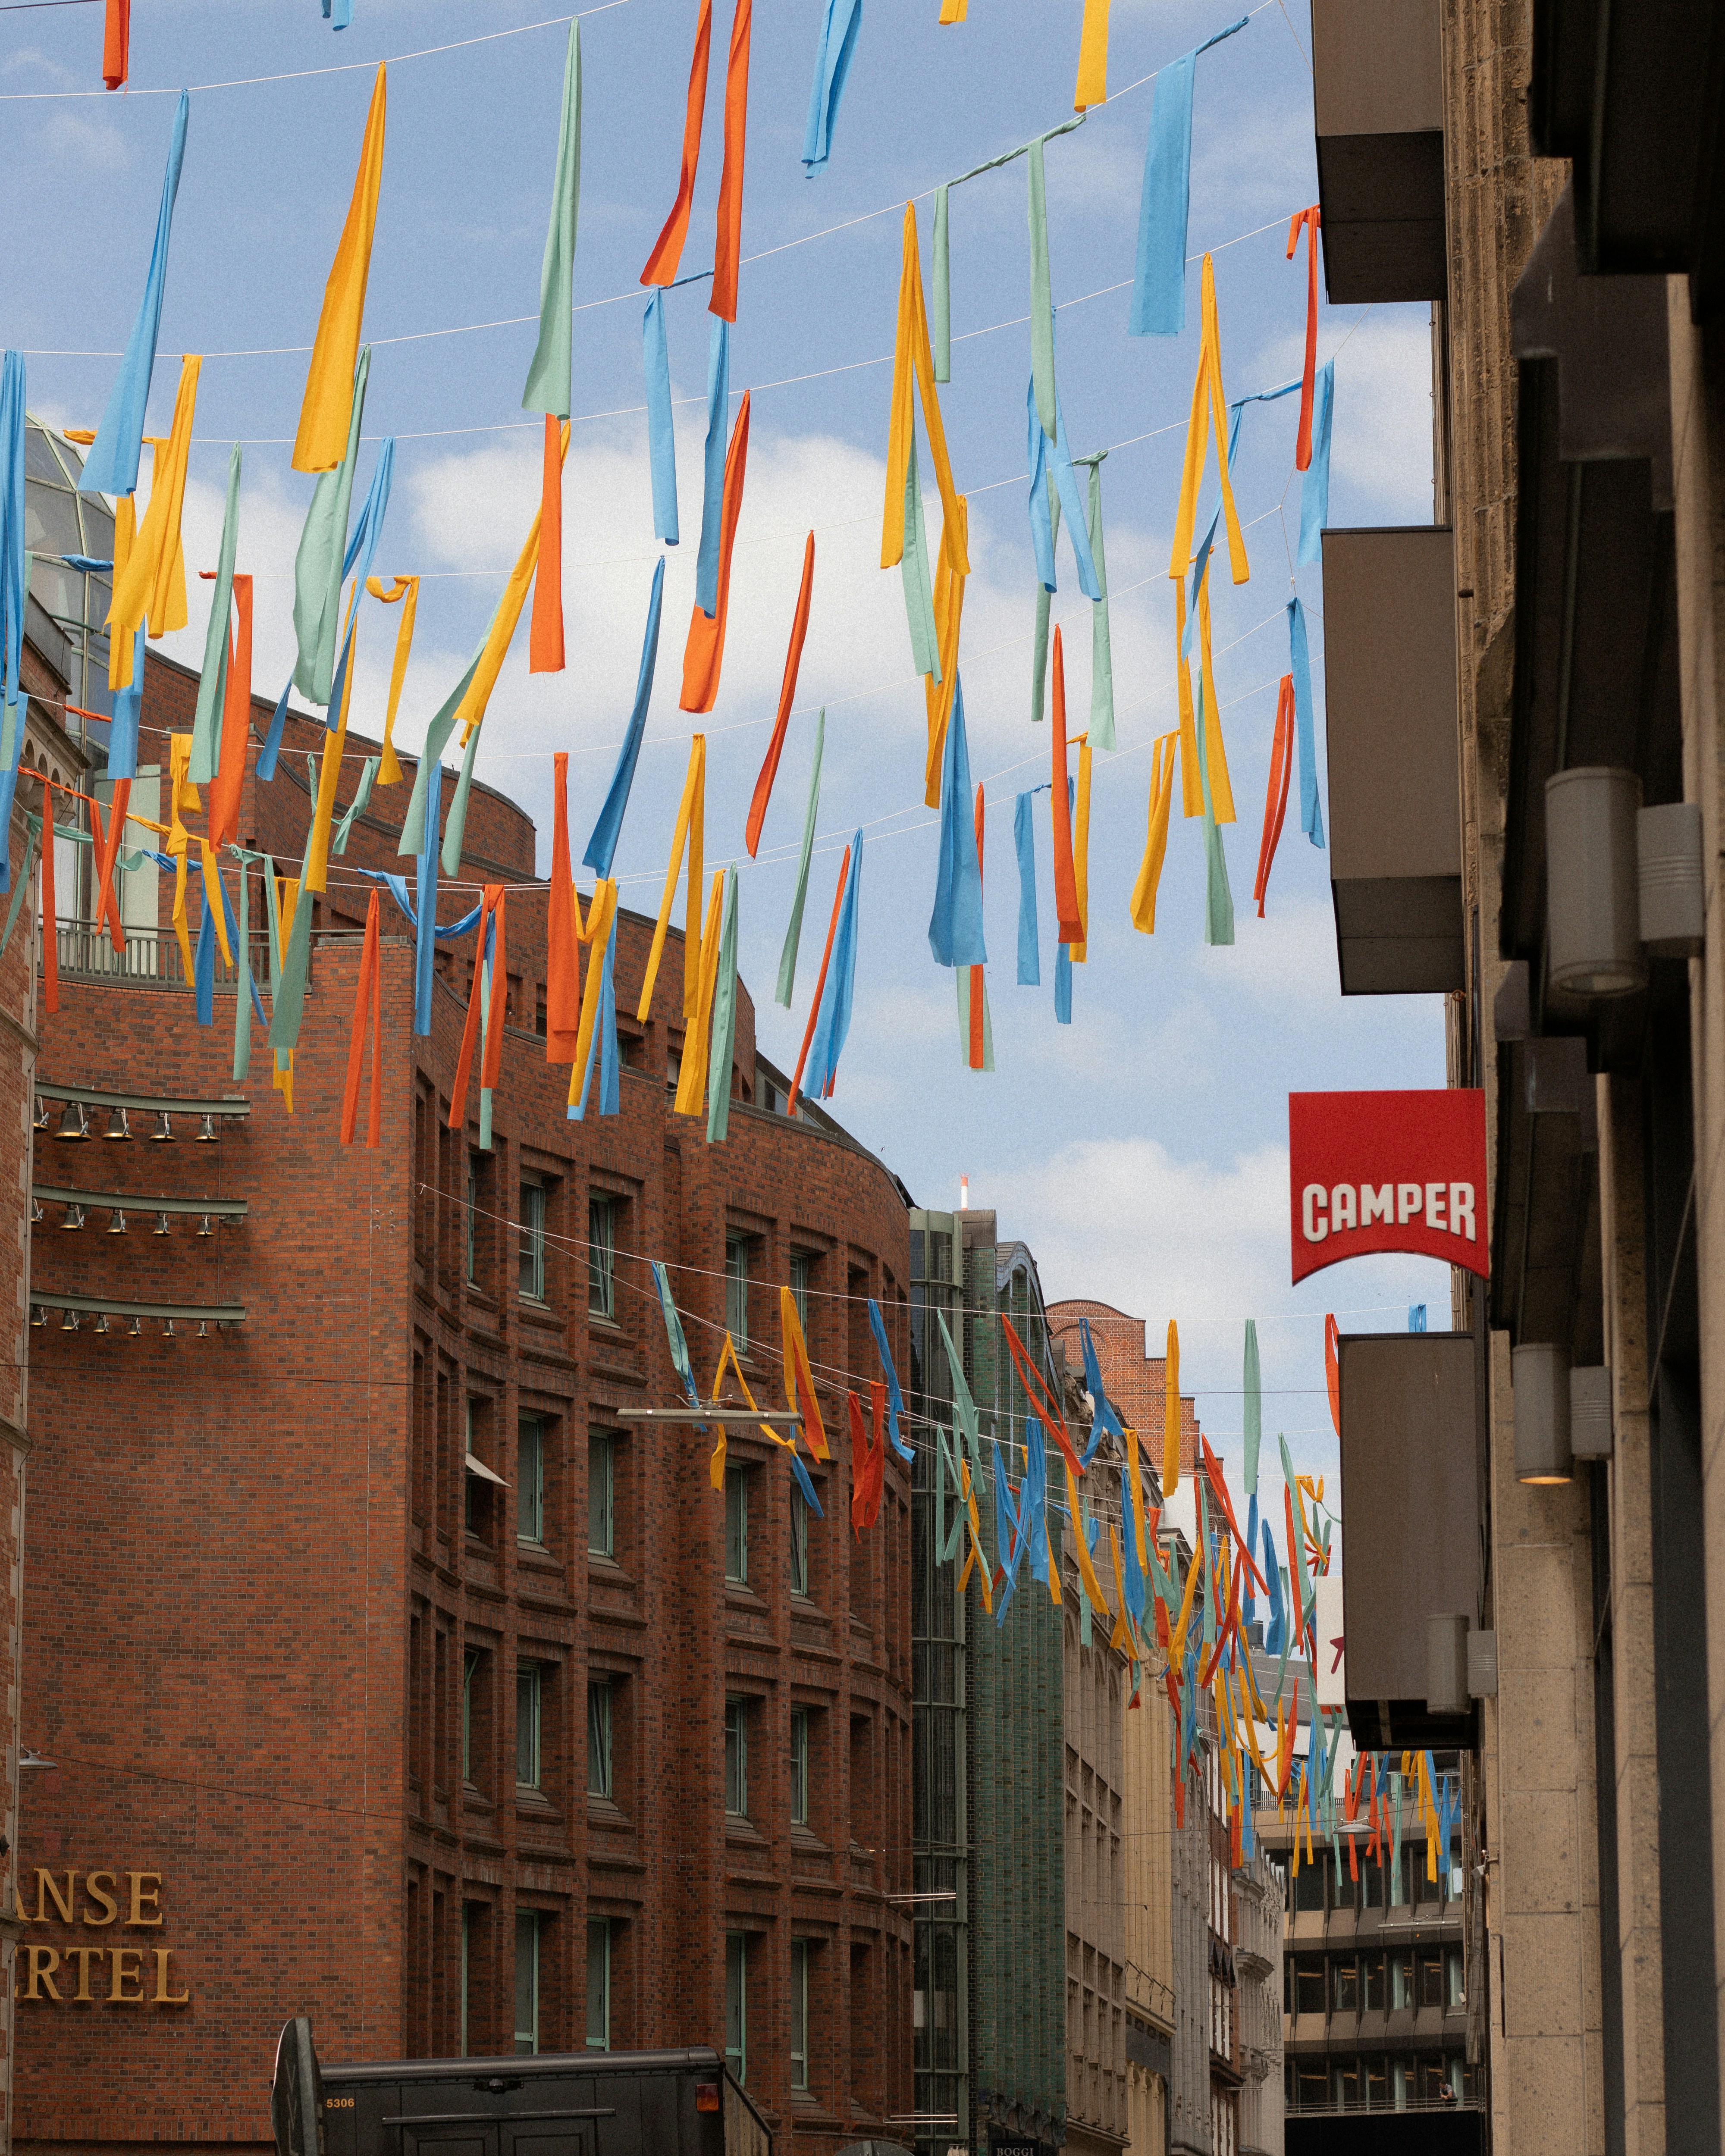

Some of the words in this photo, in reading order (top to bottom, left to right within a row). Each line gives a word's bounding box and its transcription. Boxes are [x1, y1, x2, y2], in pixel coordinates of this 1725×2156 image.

[1302, 1182, 1476, 1242] CAMPER
[15, 1945, 189, 2002] RTEL
[326, 2098, 354, 2108] 5306
[997, 2148, 1034, 2156] BOGGI
